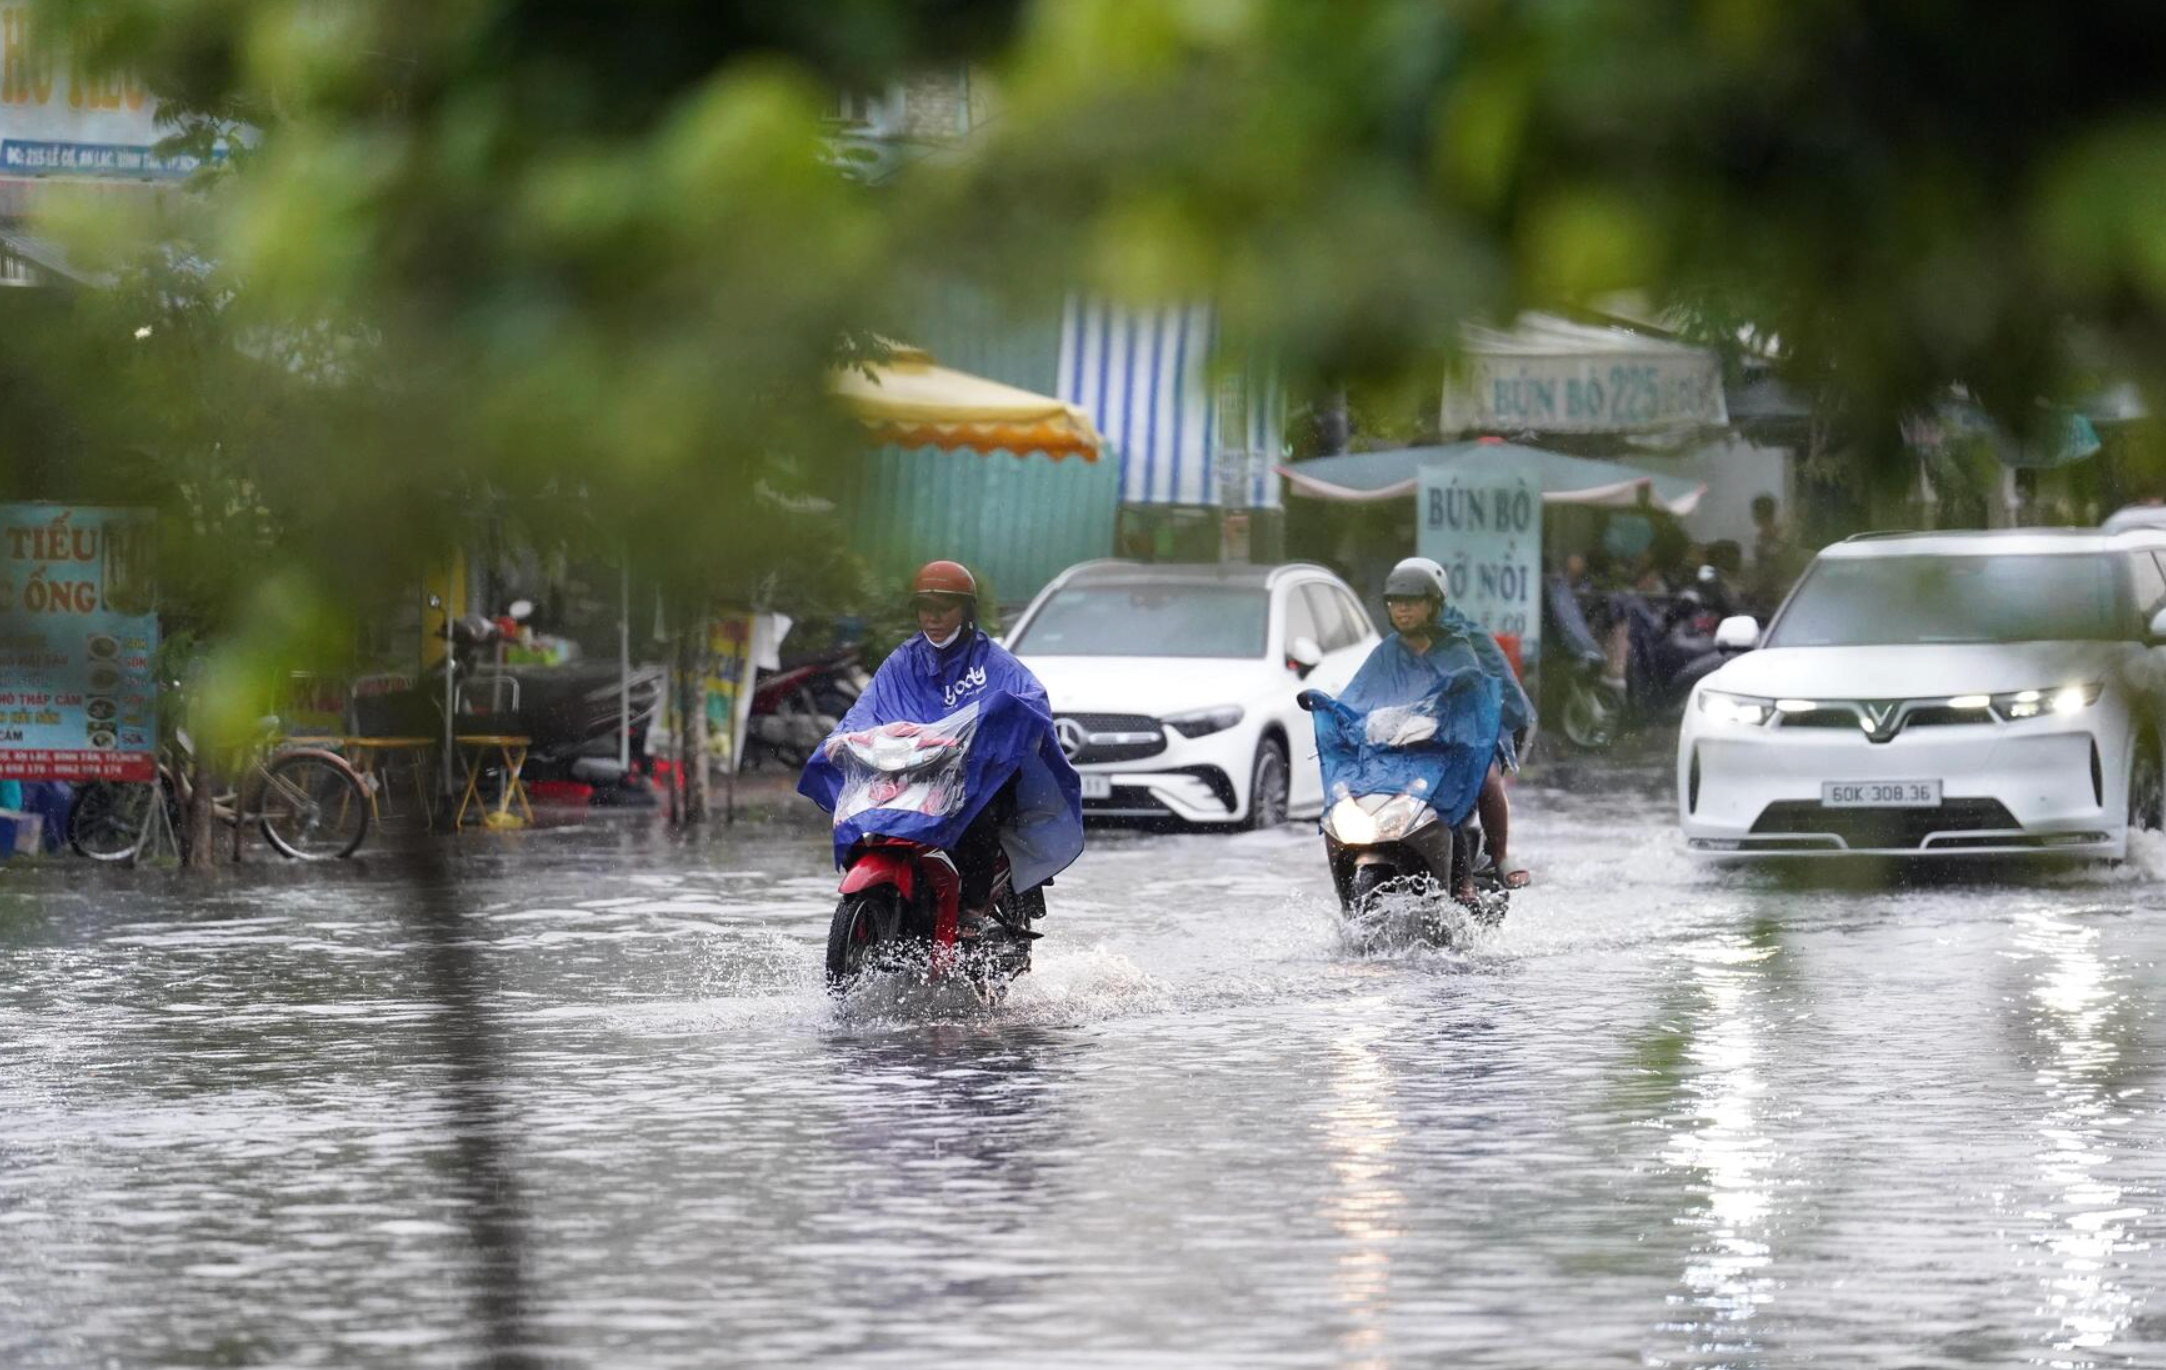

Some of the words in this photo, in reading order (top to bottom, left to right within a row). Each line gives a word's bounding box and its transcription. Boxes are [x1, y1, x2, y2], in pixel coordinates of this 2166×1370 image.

[1427, 476, 1486, 533] BÚN
[1494, 476, 1531, 534] BÒ
[7, 510, 99, 561] TIẾU
[24, 565, 97, 613] ỐNG
[944, 664, 986, 706] yody
